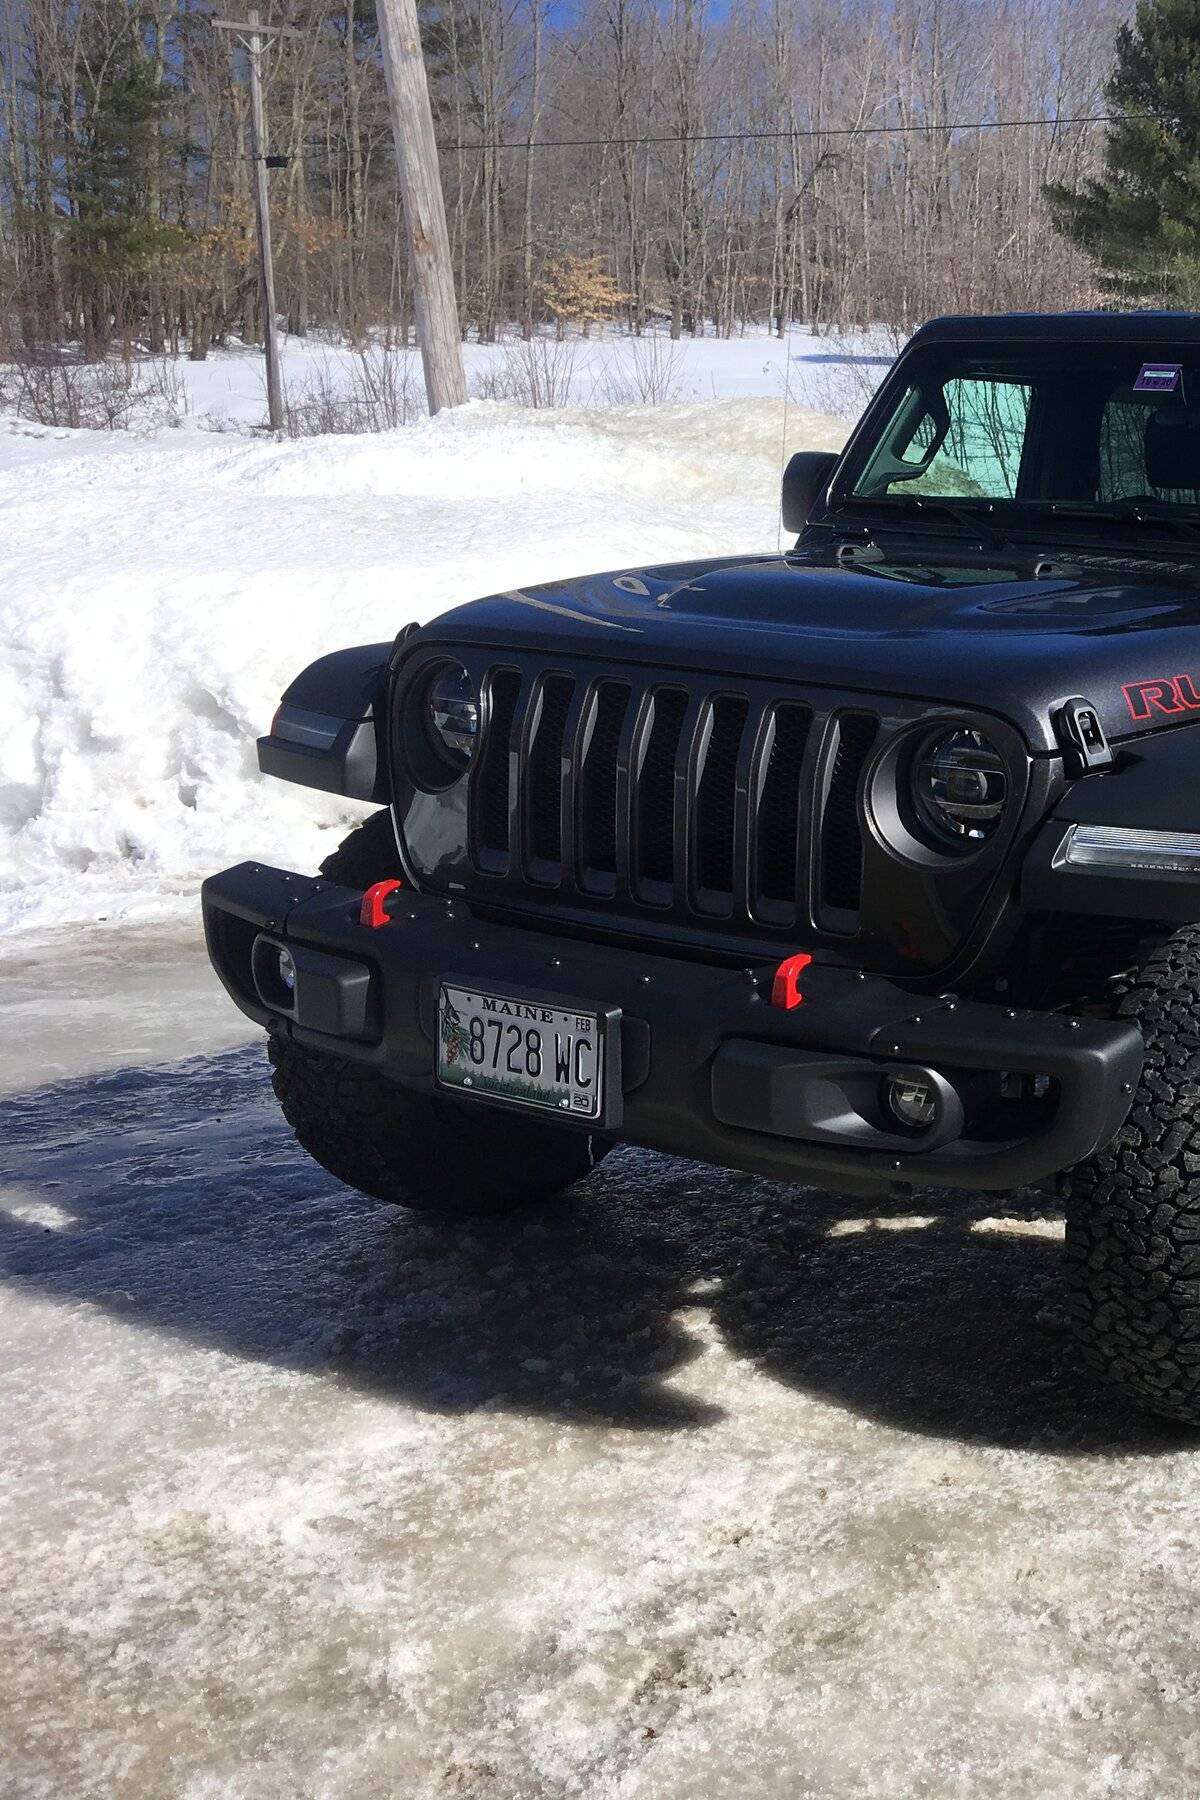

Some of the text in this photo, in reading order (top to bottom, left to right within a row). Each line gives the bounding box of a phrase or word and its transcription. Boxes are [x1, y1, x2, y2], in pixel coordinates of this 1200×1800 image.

[481, 998, 554, 1024] MAINE
[575, 1017, 591, 1032] FEB
[469, 1016, 593, 1088] 8728 WC
[573, 1094, 589, 1108] 20
